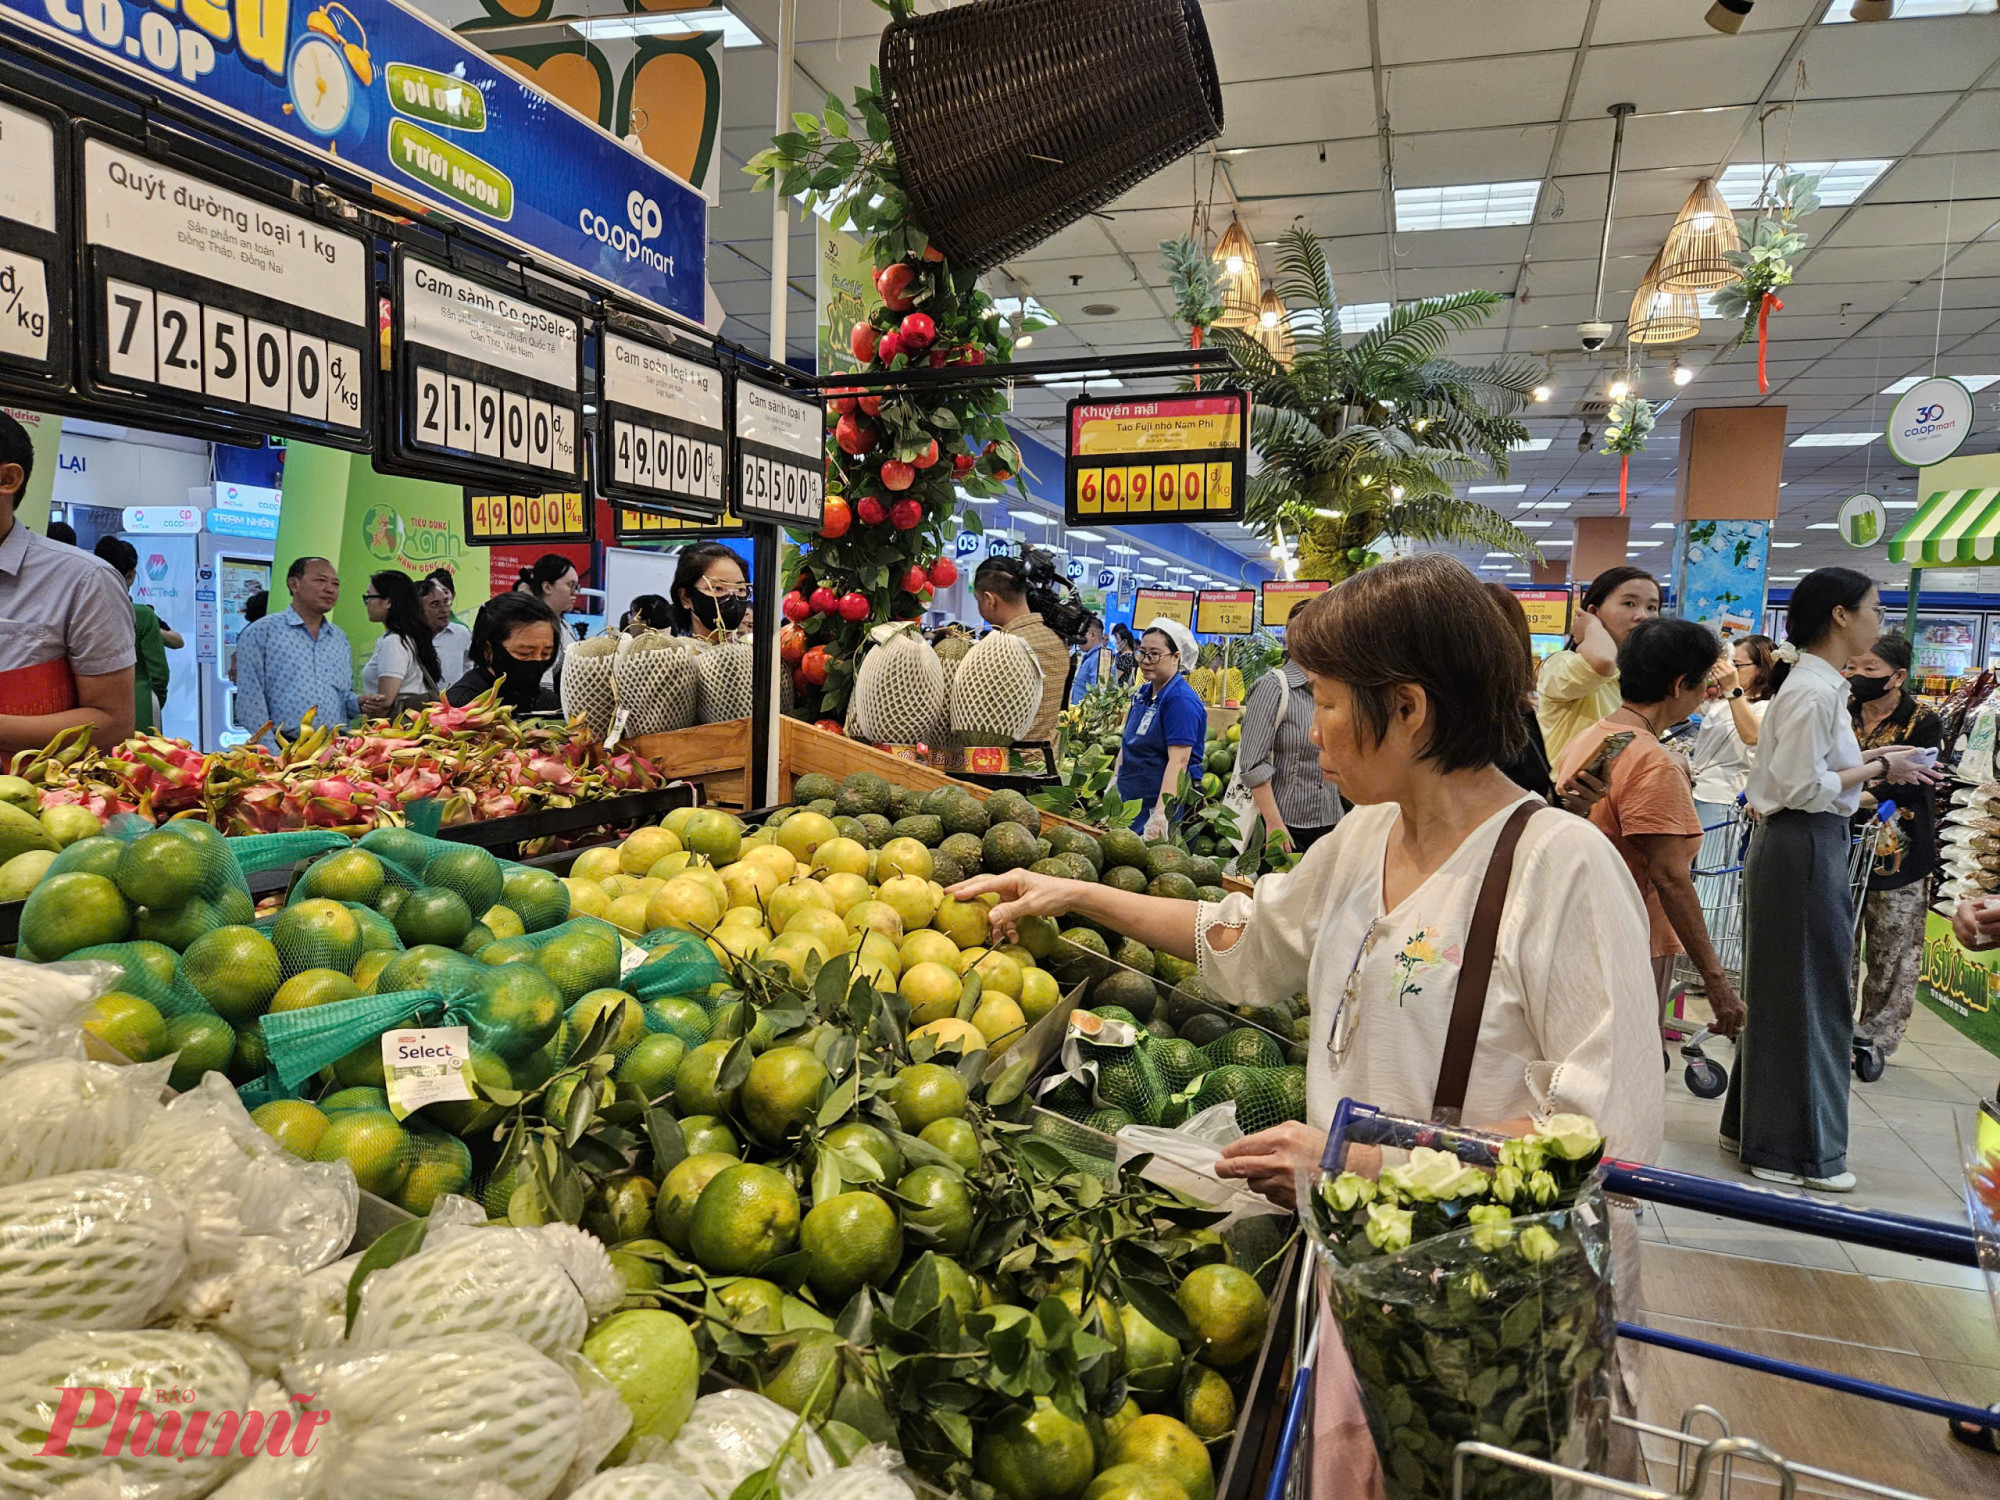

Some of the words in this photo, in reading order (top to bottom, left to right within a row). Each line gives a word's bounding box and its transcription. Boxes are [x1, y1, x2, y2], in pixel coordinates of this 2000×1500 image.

[402, 137, 449, 182] TƯƠI
[452, 166, 499, 209] NGON
[108, 161, 166, 201] Quýt
[174, 184, 249, 233] đường
[255, 211, 291, 245] loại
[297, 229, 306, 250] 1
[314, 233, 336, 263] kg
[187, 220, 208, 235] Sản
[210, 229, 238, 244] phẩm
[240, 240, 252, 250] an
[254, 244, 275, 257] toàn
[268, 261, 284, 274] Nai
[415, 269, 452, 298] Cam
[458, 287, 494, 313] sành
[114, 294, 321, 399] 72.500
[615, 345, 640, 366] Cam
[749, 392, 766, 408] Cam
[423, 384, 548, 454] 21.900
[1080, 403, 1130, 420] Khuyến
[1134, 403, 1158, 416] mãi
[1135, 422, 1152, 431] Fuji
[1175, 420, 1196, 429] Nam
[1198, 419, 1214, 428] Phi
[59, 453, 86, 474] LẠI
[619, 431, 702, 483] 49.000
[746, 463, 808, 504] 25.500
[1081, 472, 1200, 503] 60.900
[476, 499, 560, 526] 49.000
[958, 535, 977, 550] 03
[990, 543, 1008, 557] 04
[1067, 564, 1082, 576] 06
[1099, 574, 1113, 584] 07
[399, 1044, 454, 1059] Select
